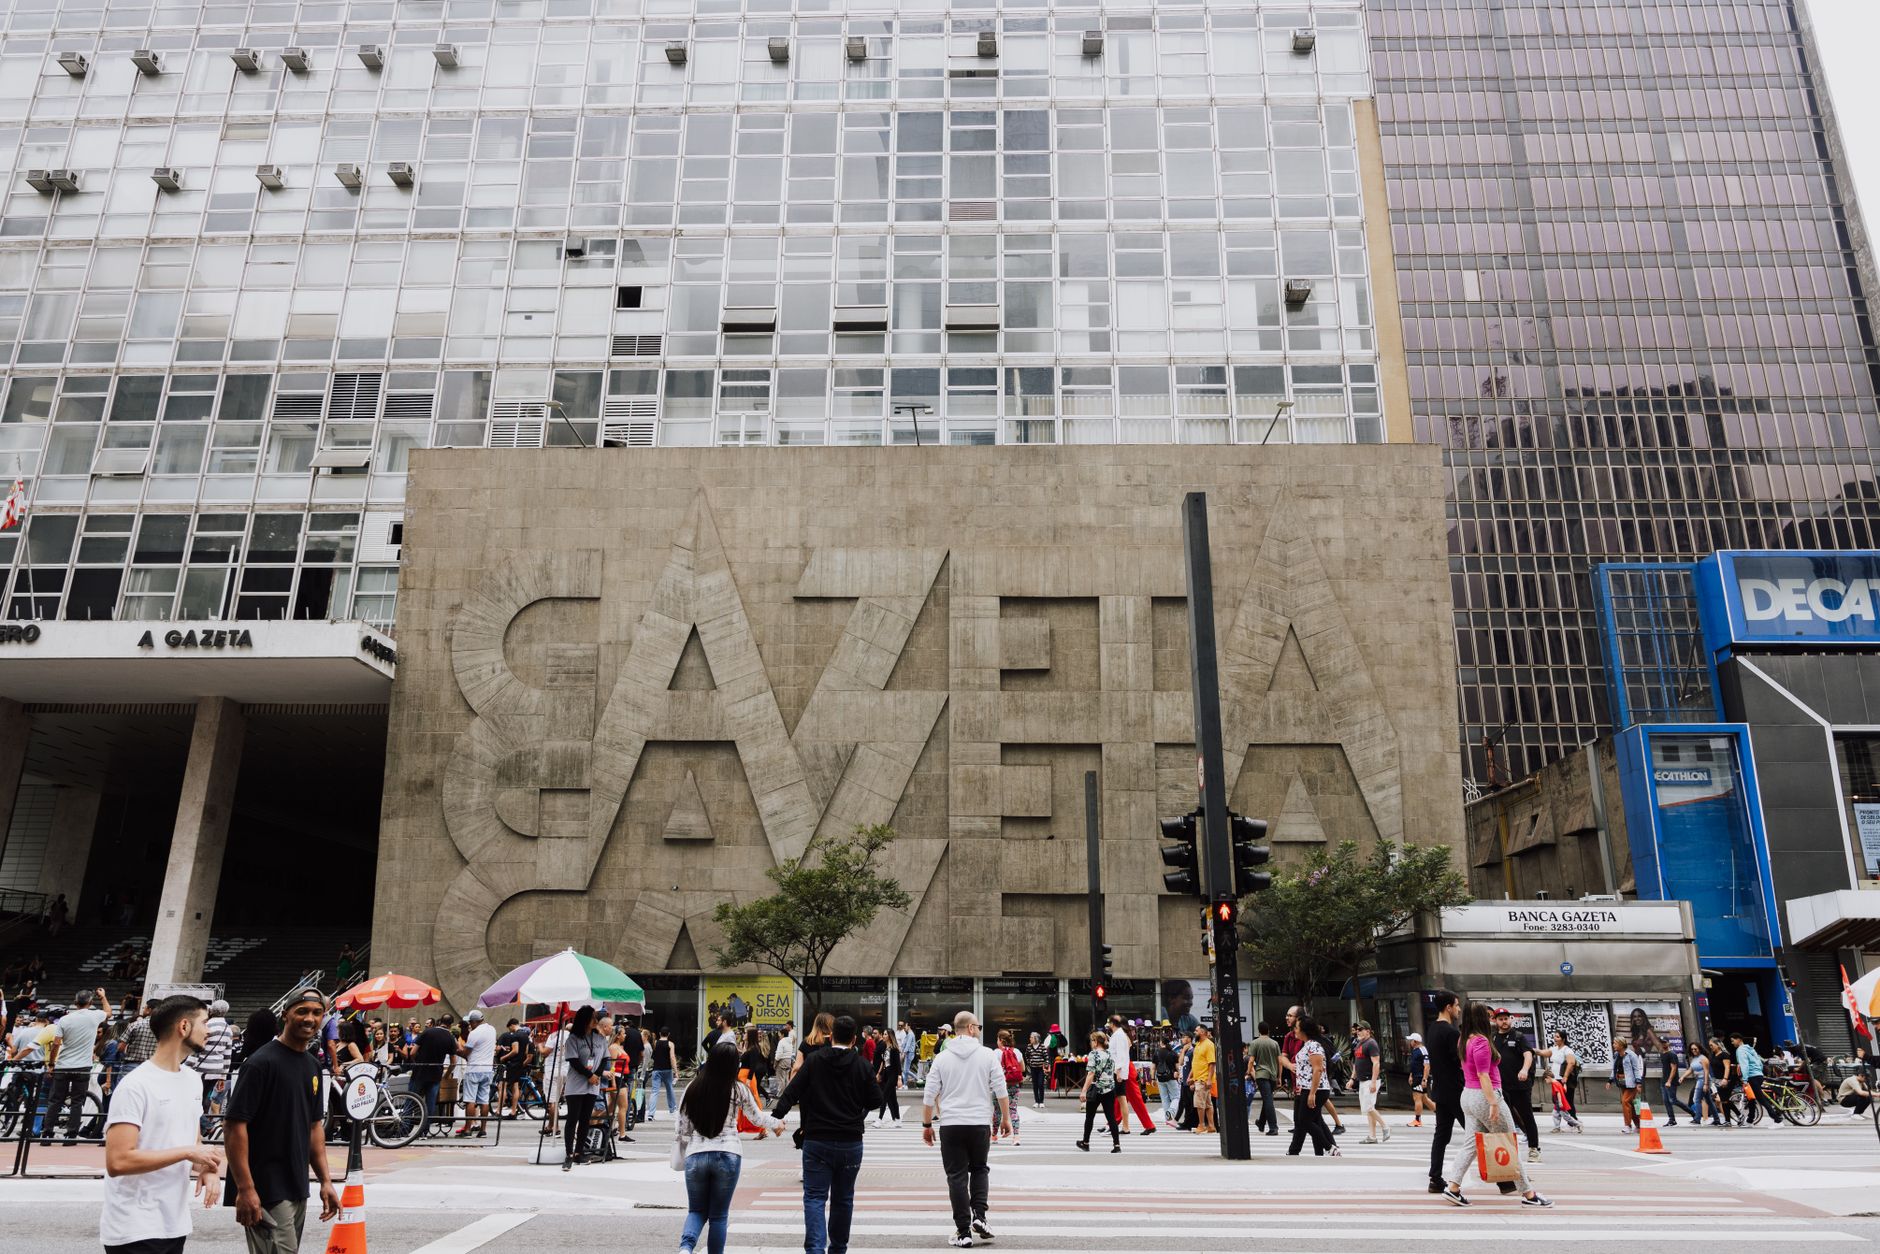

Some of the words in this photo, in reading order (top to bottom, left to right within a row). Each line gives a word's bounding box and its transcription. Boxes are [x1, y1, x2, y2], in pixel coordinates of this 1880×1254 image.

[138, 630, 153, 648] A
[165, 630, 252, 648] GAZETA
[1508, 911, 1558, 922] BANCA
[1562, 911, 1617, 922] GAZETA
[1523, 923, 1548, 931] Fone:
[1551, 923, 1600, 931] 3283-0340
[822, 976, 868, 985] Restaurante
[756, 993, 790, 1007] SEM
[756, 1008, 790, 1017] URSOS
